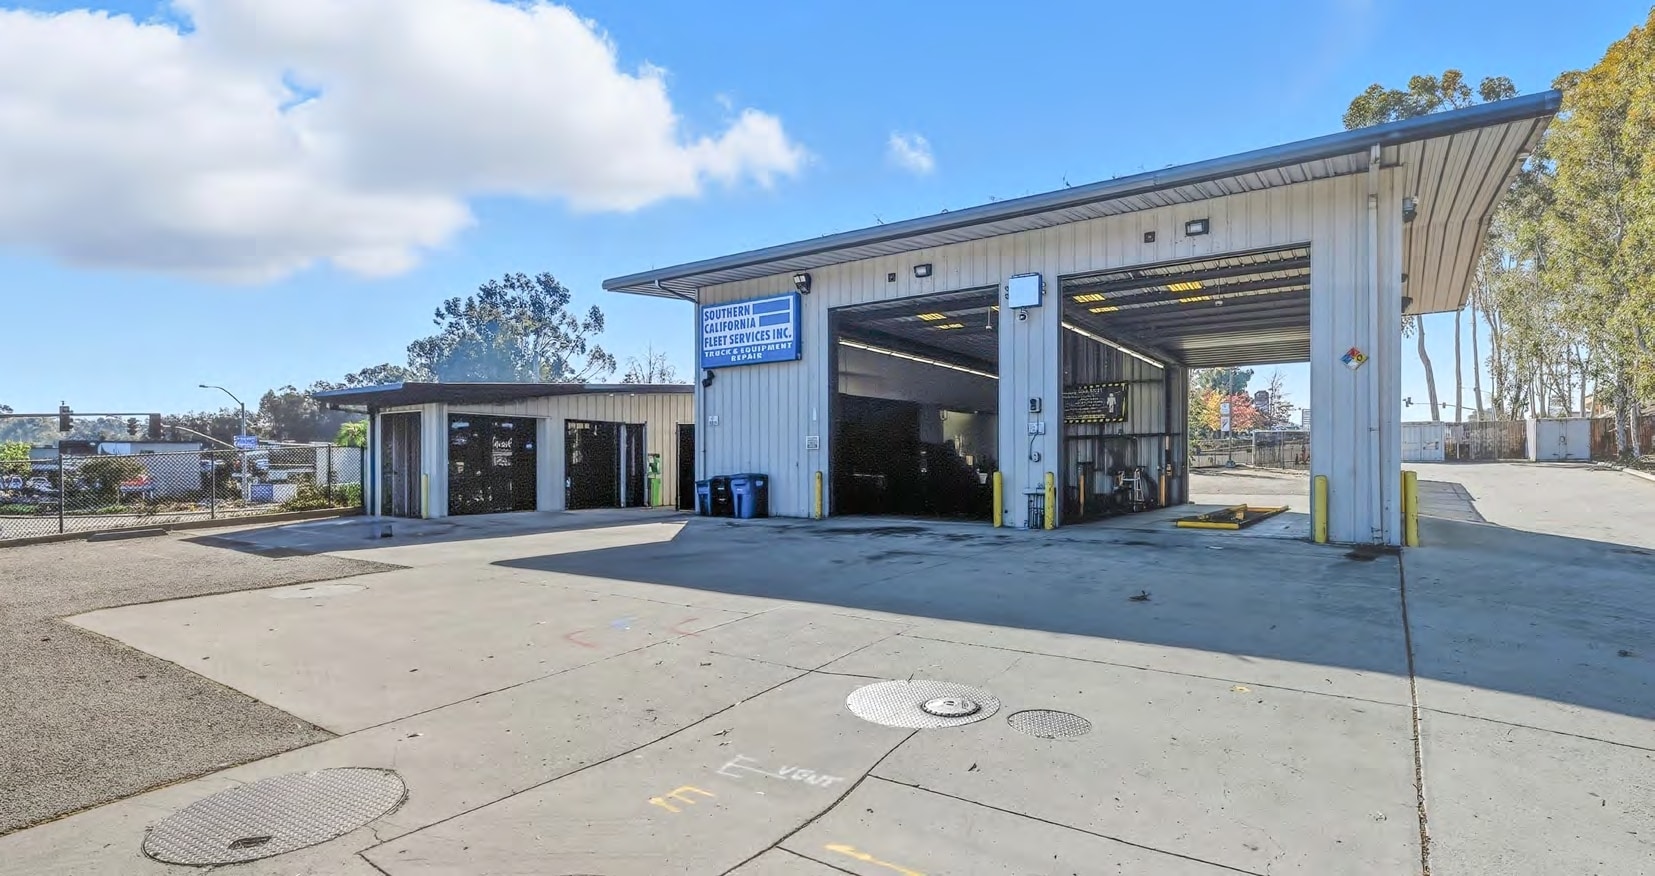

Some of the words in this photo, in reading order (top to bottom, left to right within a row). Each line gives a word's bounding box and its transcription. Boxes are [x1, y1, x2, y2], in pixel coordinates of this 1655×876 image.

[704, 305, 750, 321] SOUTHERN
[704, 318, 756, 334] CALIFORNIA
[704, 335, 727, 348] FLEET
[729, 330, 770, 345] SERVICES
[773, 327, 792, 340] INC.
[704, 349, 731, 357] TRUCK
[741, 342, 792, 353] EQUIPMENT
[731, 353, 762, 361] REPAIR
